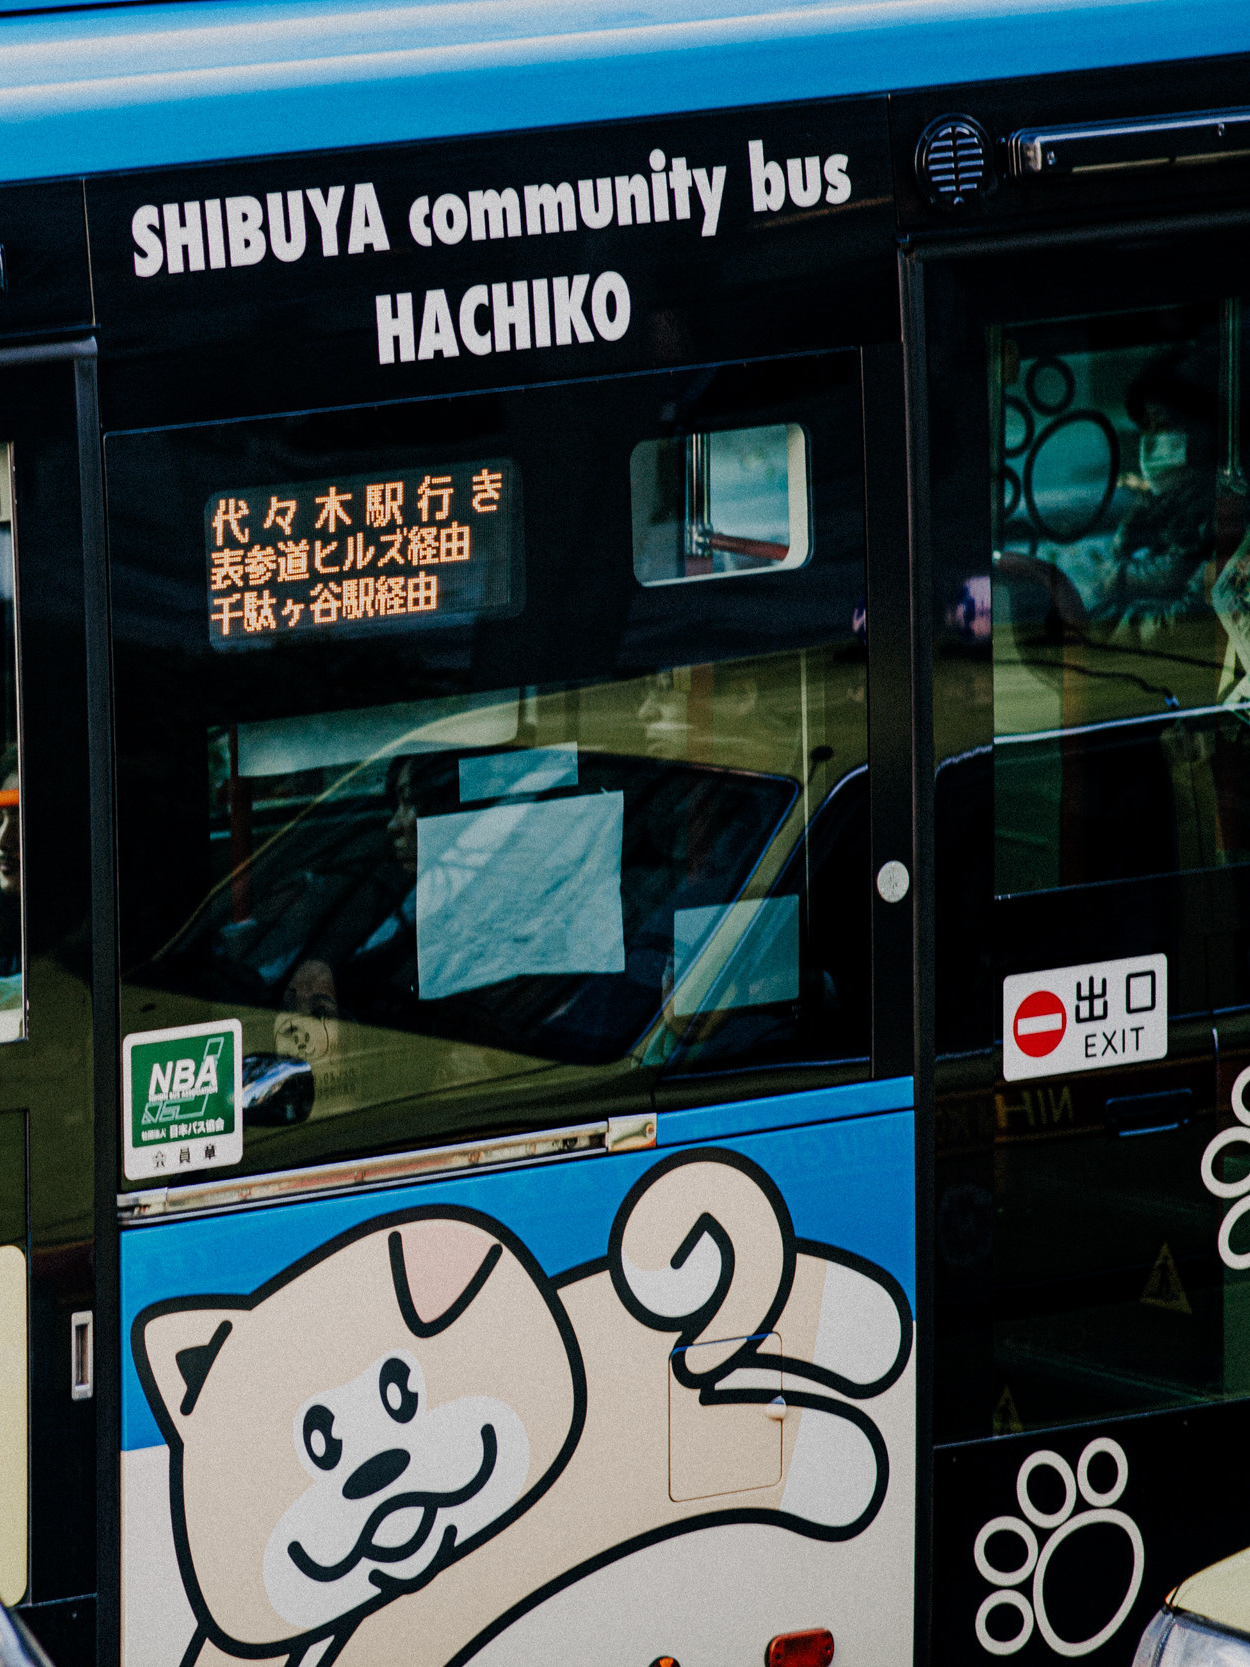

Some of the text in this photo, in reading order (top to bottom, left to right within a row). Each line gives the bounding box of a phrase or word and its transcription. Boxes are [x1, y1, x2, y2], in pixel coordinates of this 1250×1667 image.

[131, 140, 852, 277] SHIBUYA community bus
[376, 270, 632, 365] HACHIKO
[212, 469, 502, 546] 代々木駅行き
[211, 521, 471, 590] 表参道ヒルズ経由
[211, 571, 438, 635] 千駄ヶ谷駅経由
[1075, 969, 1157, 1024] 出口
[1085, 1026, 1145, 1058] EXIT
[149, 1055, 218, 1098] NBA
